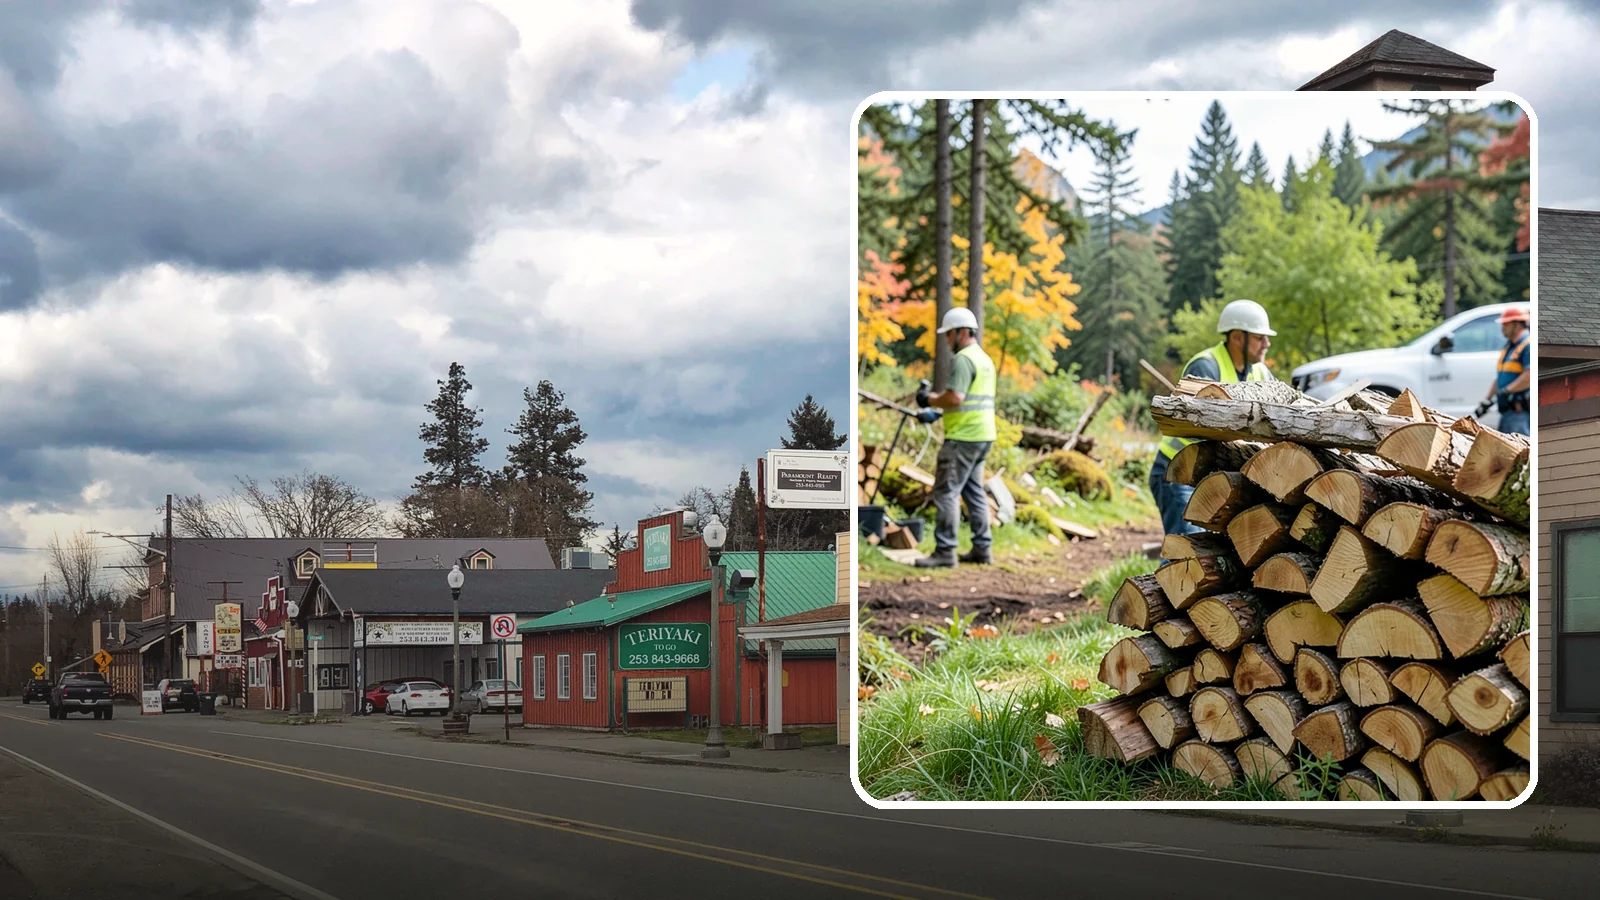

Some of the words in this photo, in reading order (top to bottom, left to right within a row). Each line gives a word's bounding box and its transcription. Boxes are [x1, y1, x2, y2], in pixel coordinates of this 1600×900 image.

[624, 627, 702, 646] TERIYAKI
[629, 654, 648, 664] 253
[652, 654, 700, 664] 843-9668
